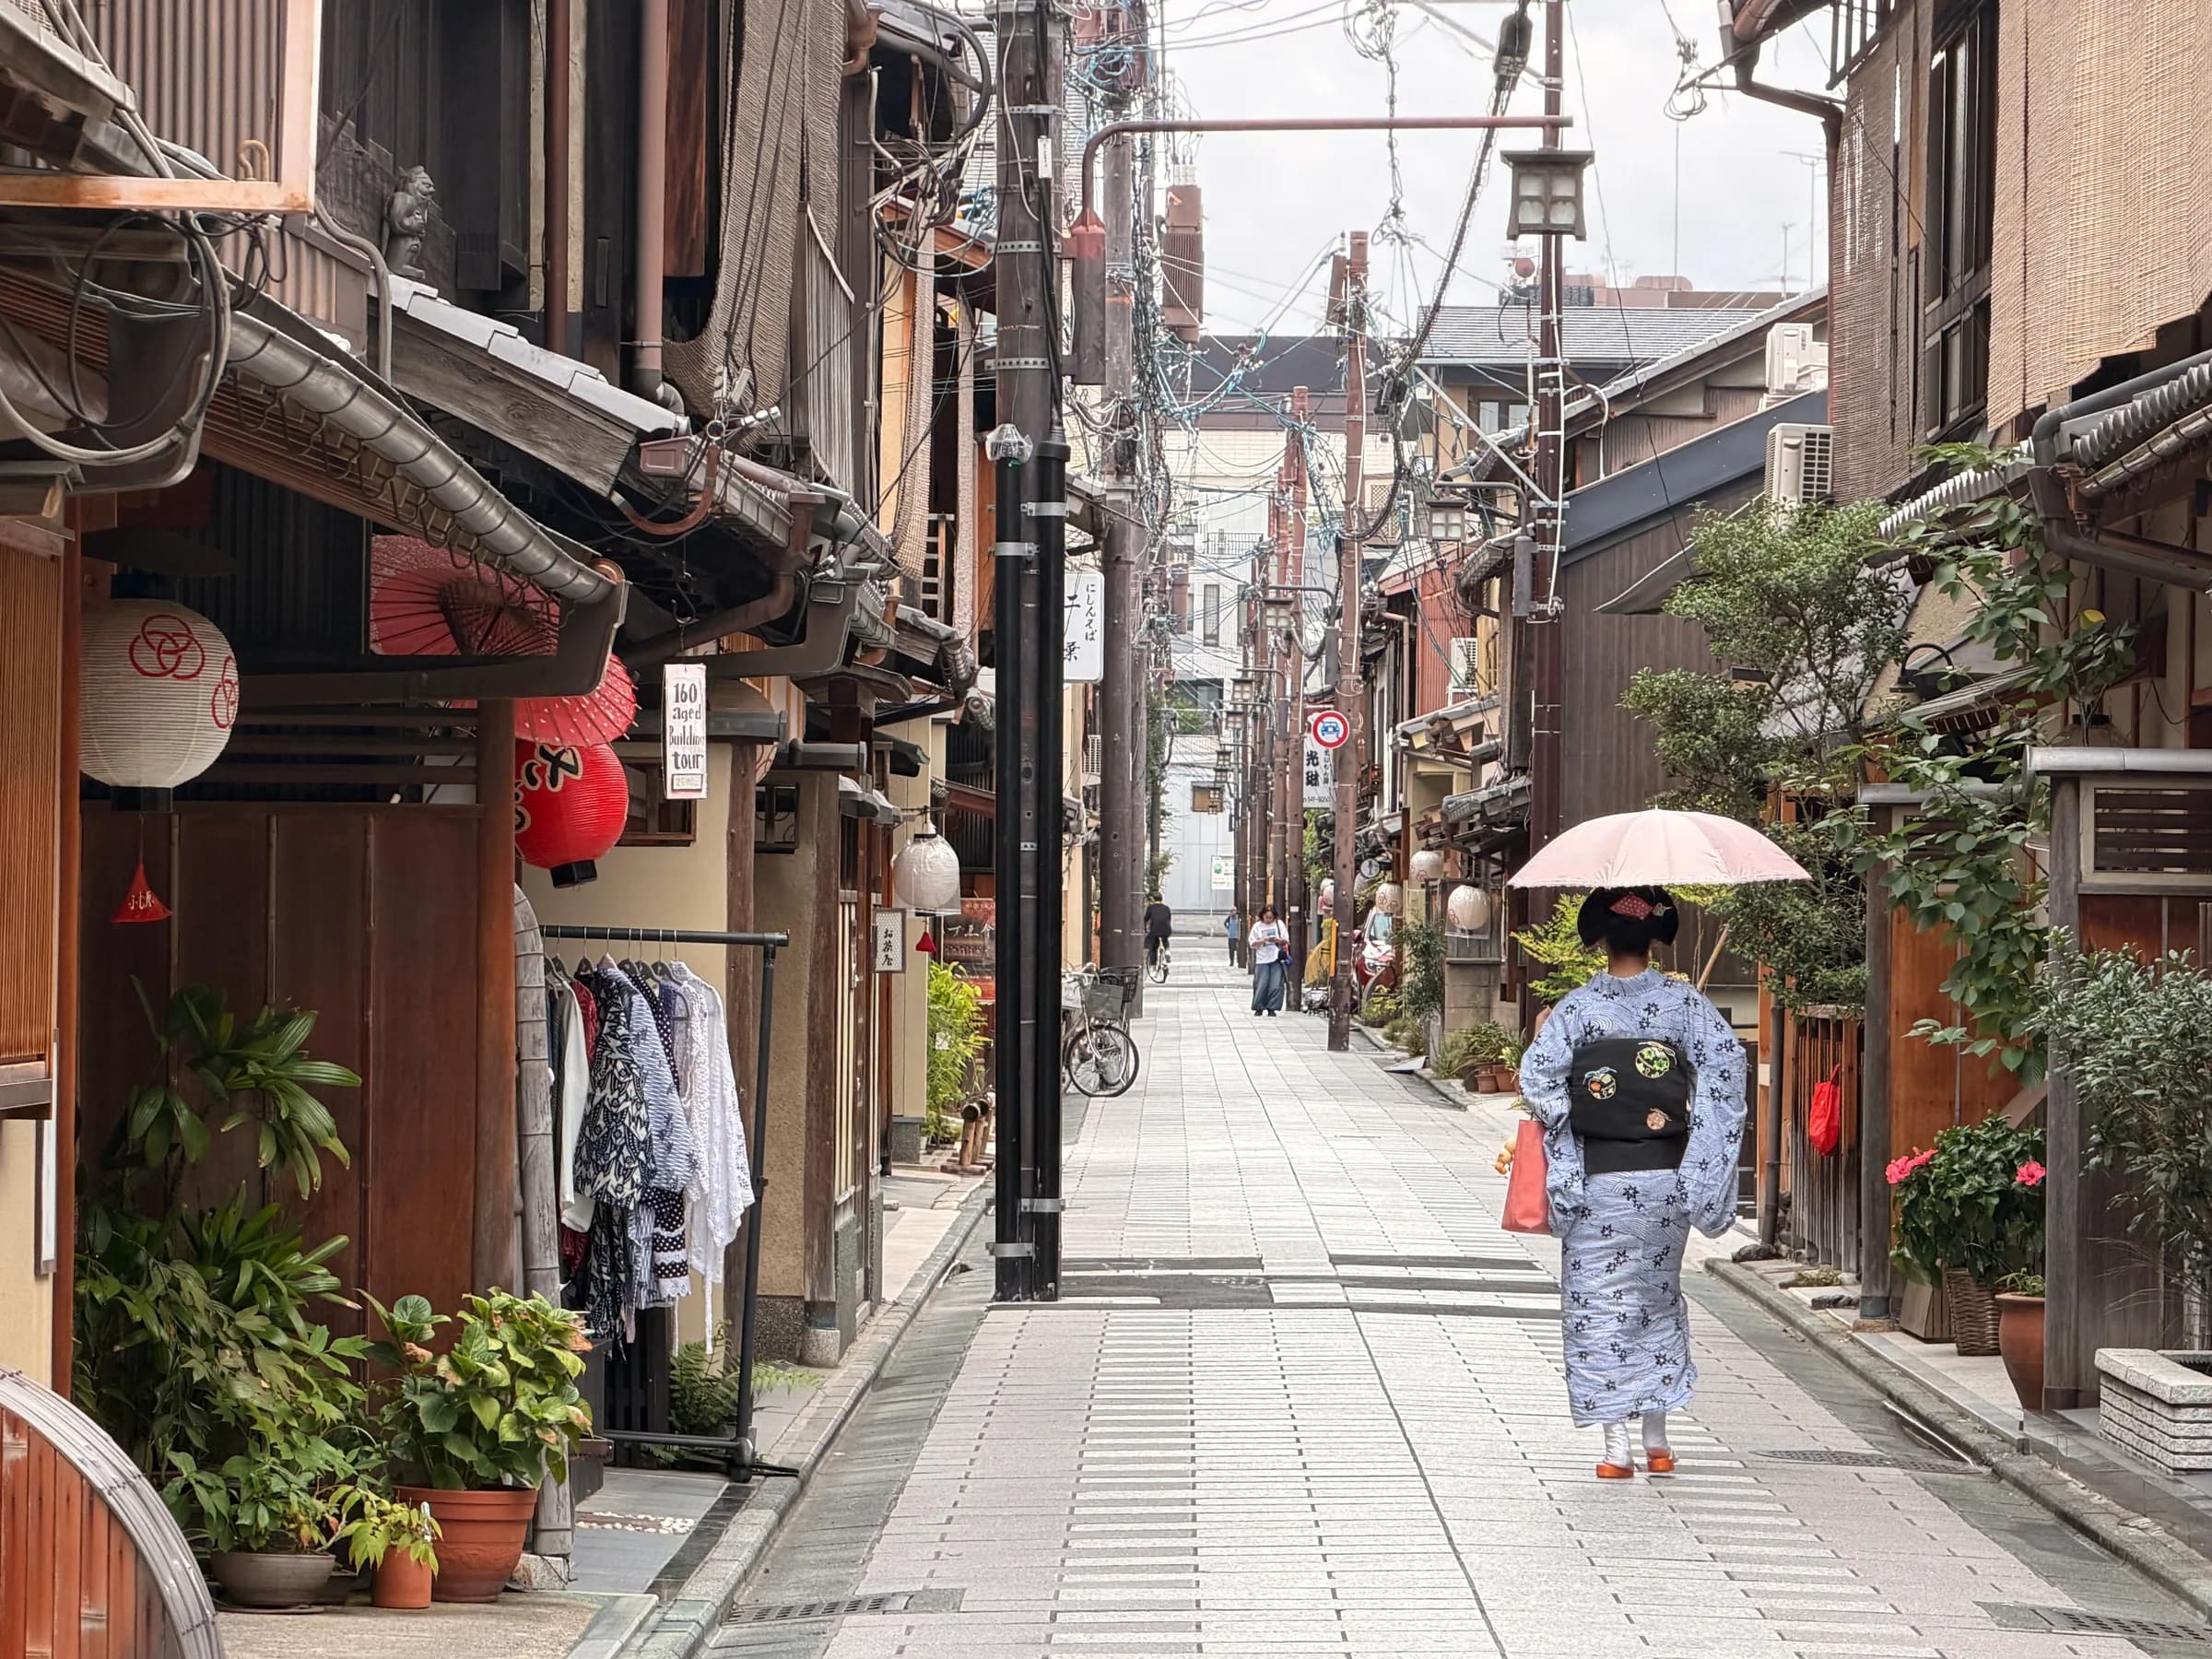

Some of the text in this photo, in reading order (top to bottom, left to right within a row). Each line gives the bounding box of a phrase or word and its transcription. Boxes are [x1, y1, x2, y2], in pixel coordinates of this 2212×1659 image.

[1085, 583, 1098, 641] にしんそば
[673, 683, 698, 703] 160
[672, 703, 701, 723] aged
[672, 751, 704, 770] tour
